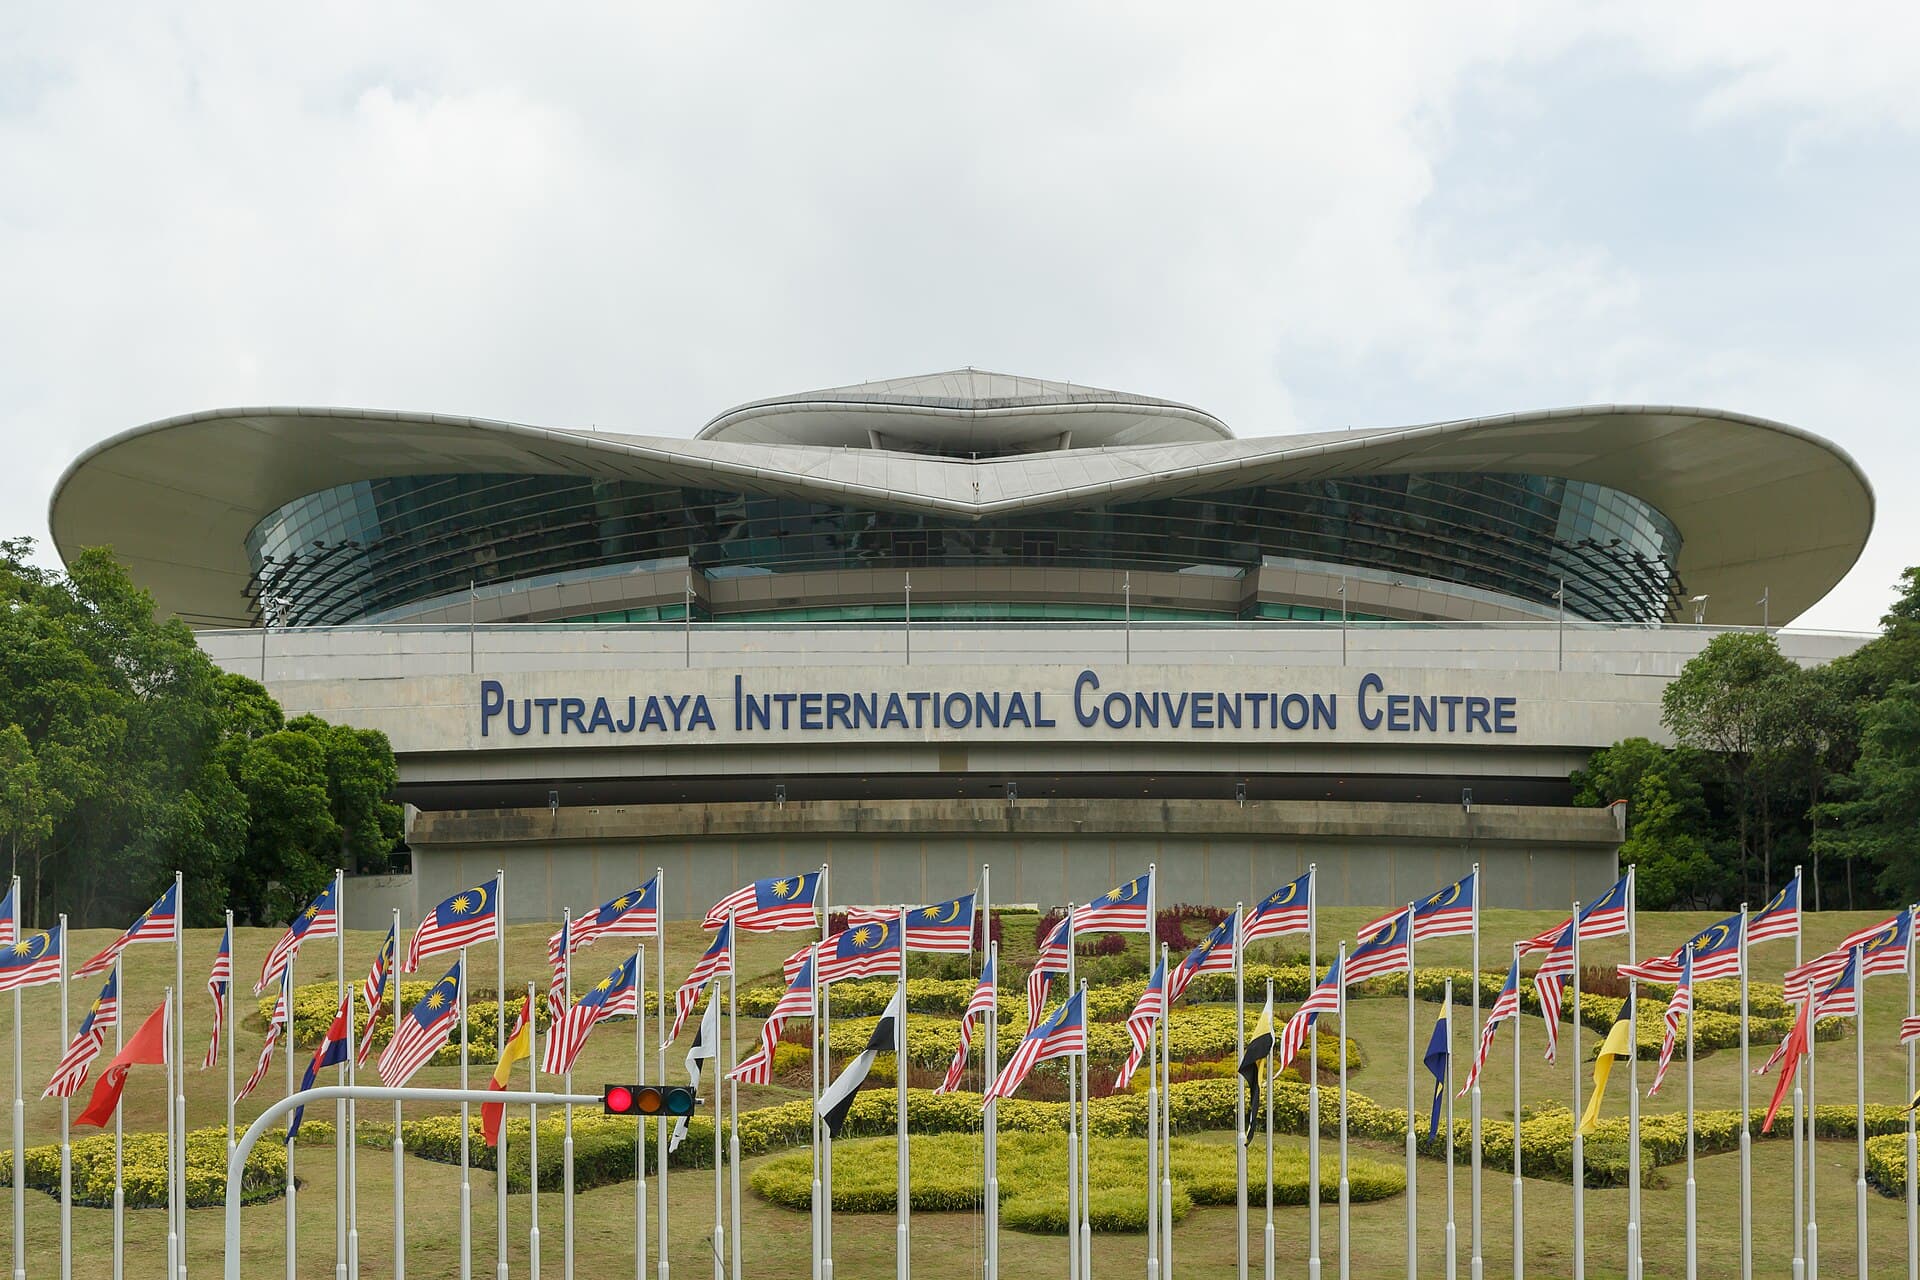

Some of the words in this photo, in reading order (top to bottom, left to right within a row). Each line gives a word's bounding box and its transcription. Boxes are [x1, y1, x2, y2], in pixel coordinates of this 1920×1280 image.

[480, 680, 716, 737] PUTRAJAYA
[734, 674, 1056, 732] INTERNATIONAL
[1074, 669, 1337, 731] CONVENTION
[1357, 672, 1518, 734] CENTRE
